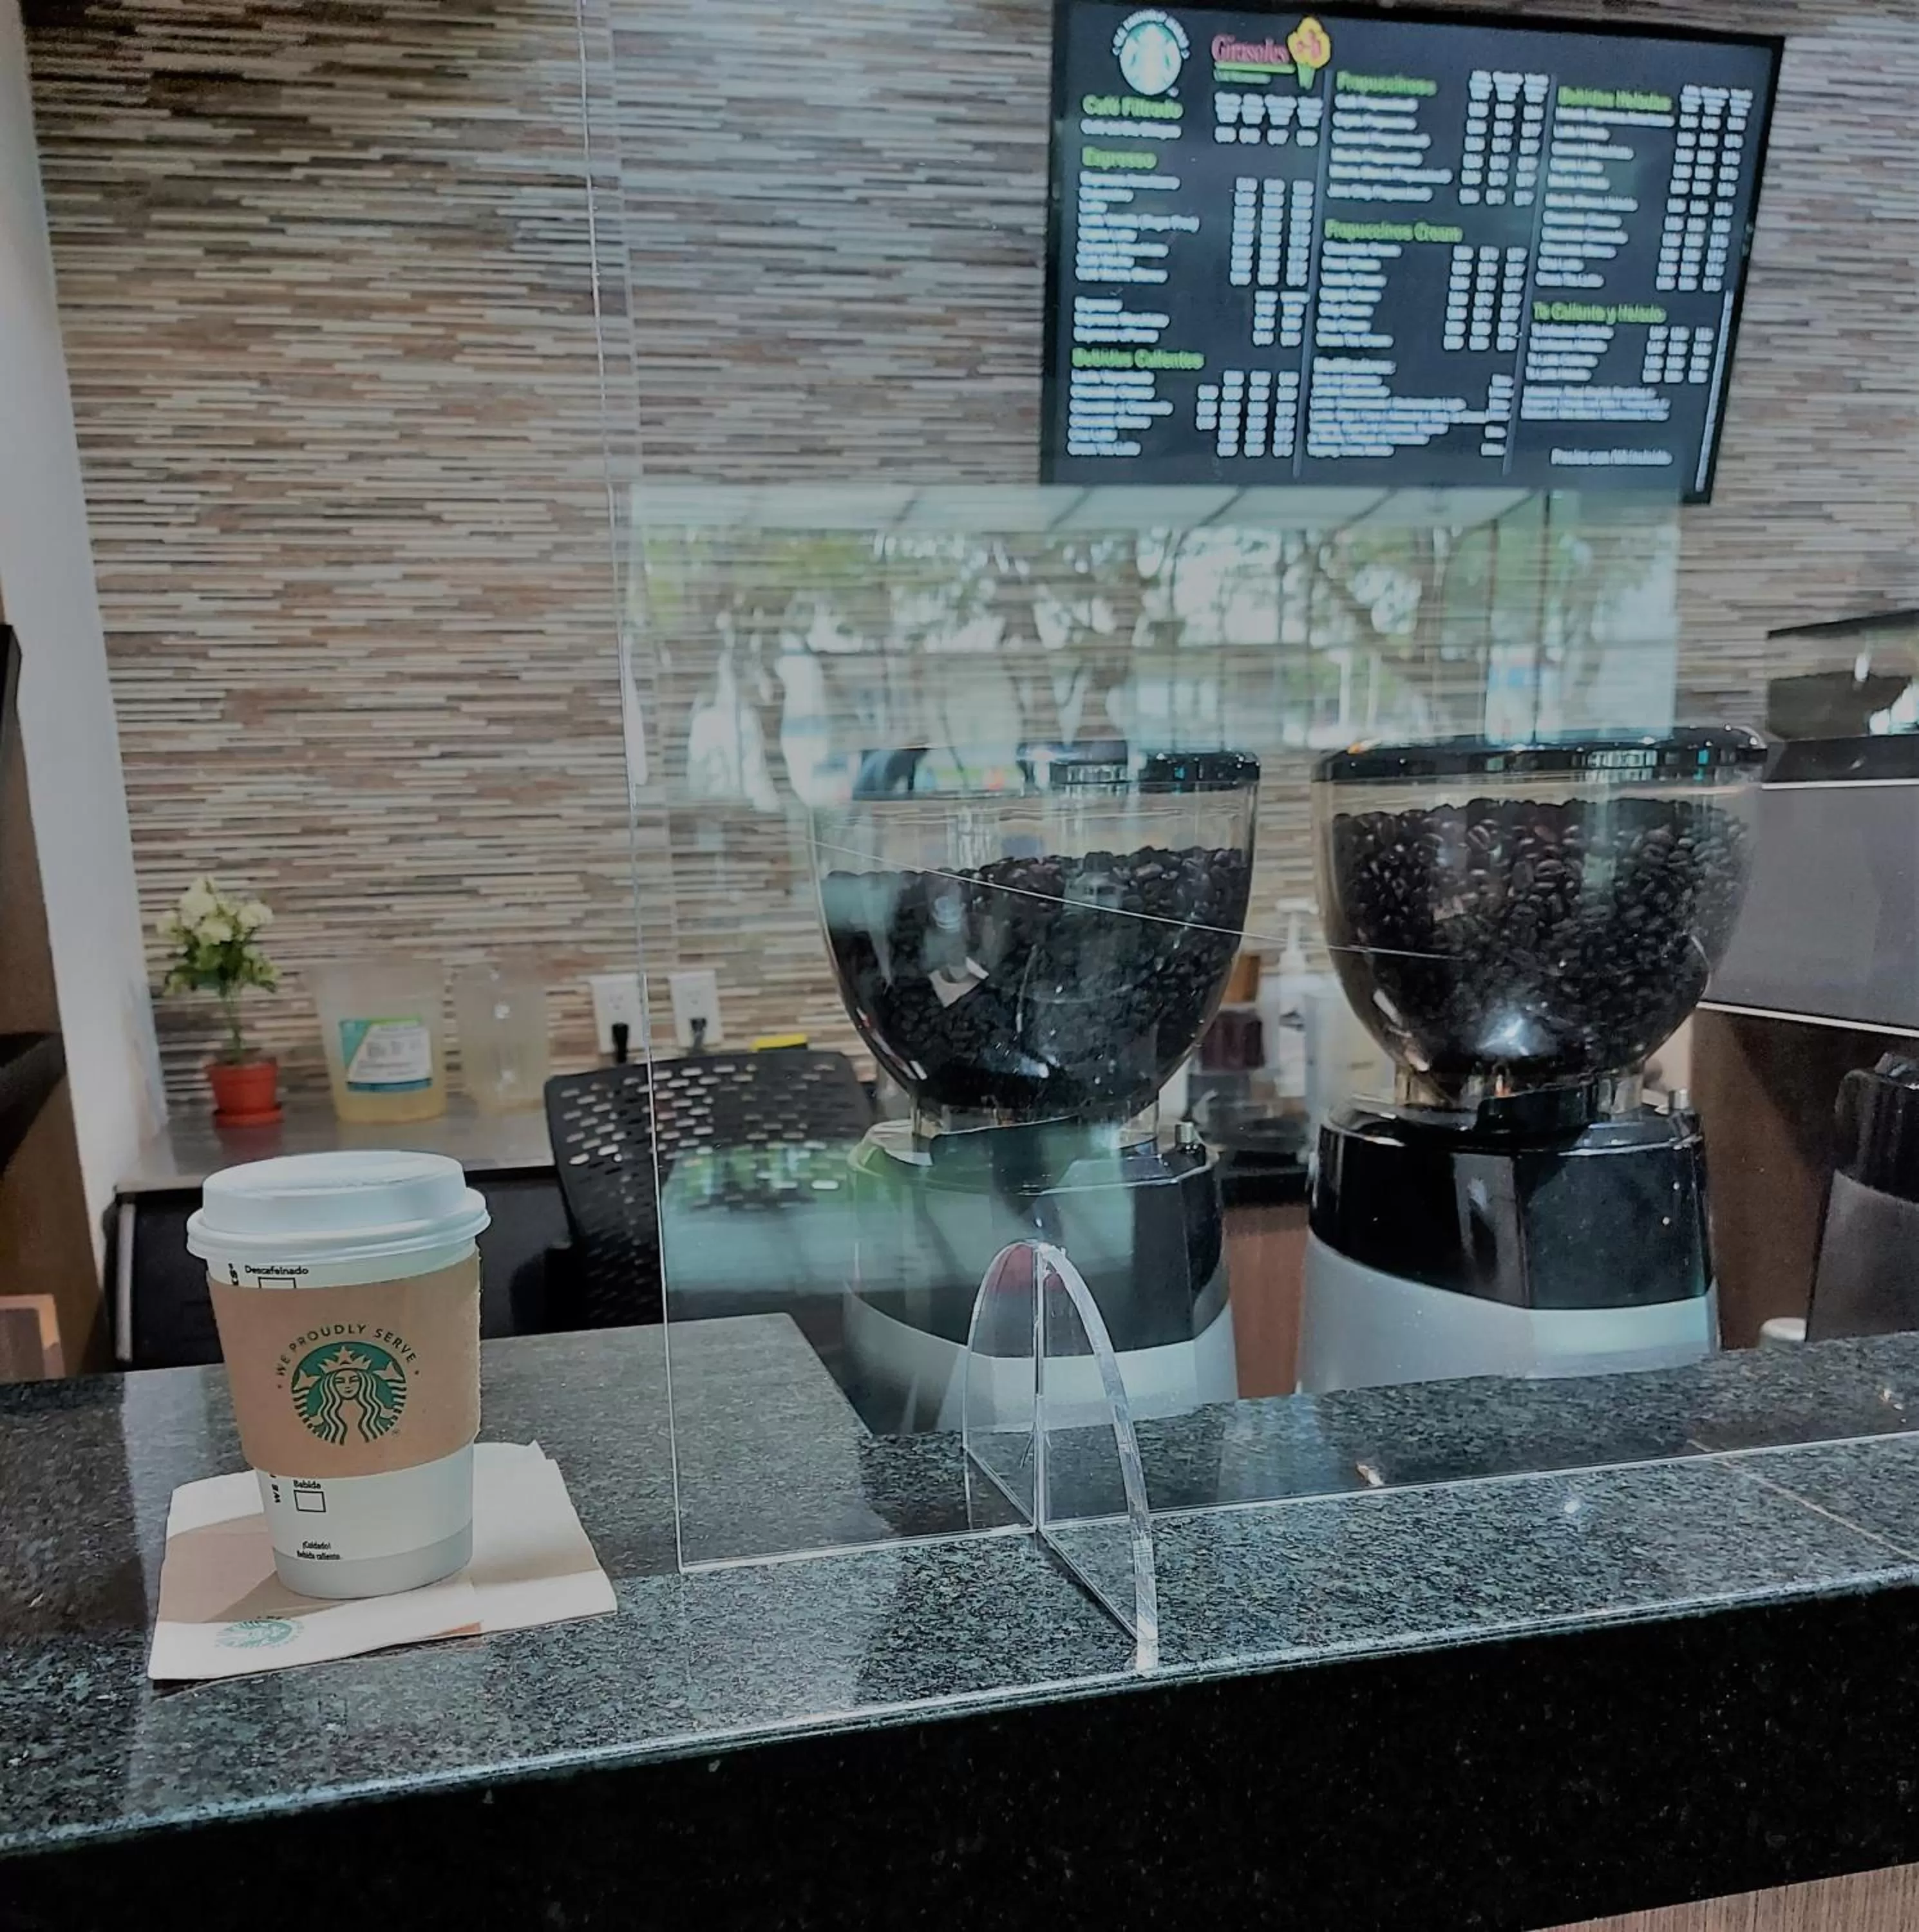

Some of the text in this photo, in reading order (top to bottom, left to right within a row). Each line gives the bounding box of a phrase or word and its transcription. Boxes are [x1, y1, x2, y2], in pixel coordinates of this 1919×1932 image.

[245, 1265, 308, 1275] Descafeinado
[276, 1324, 417, 1376] WE PROUDLY SERVE
